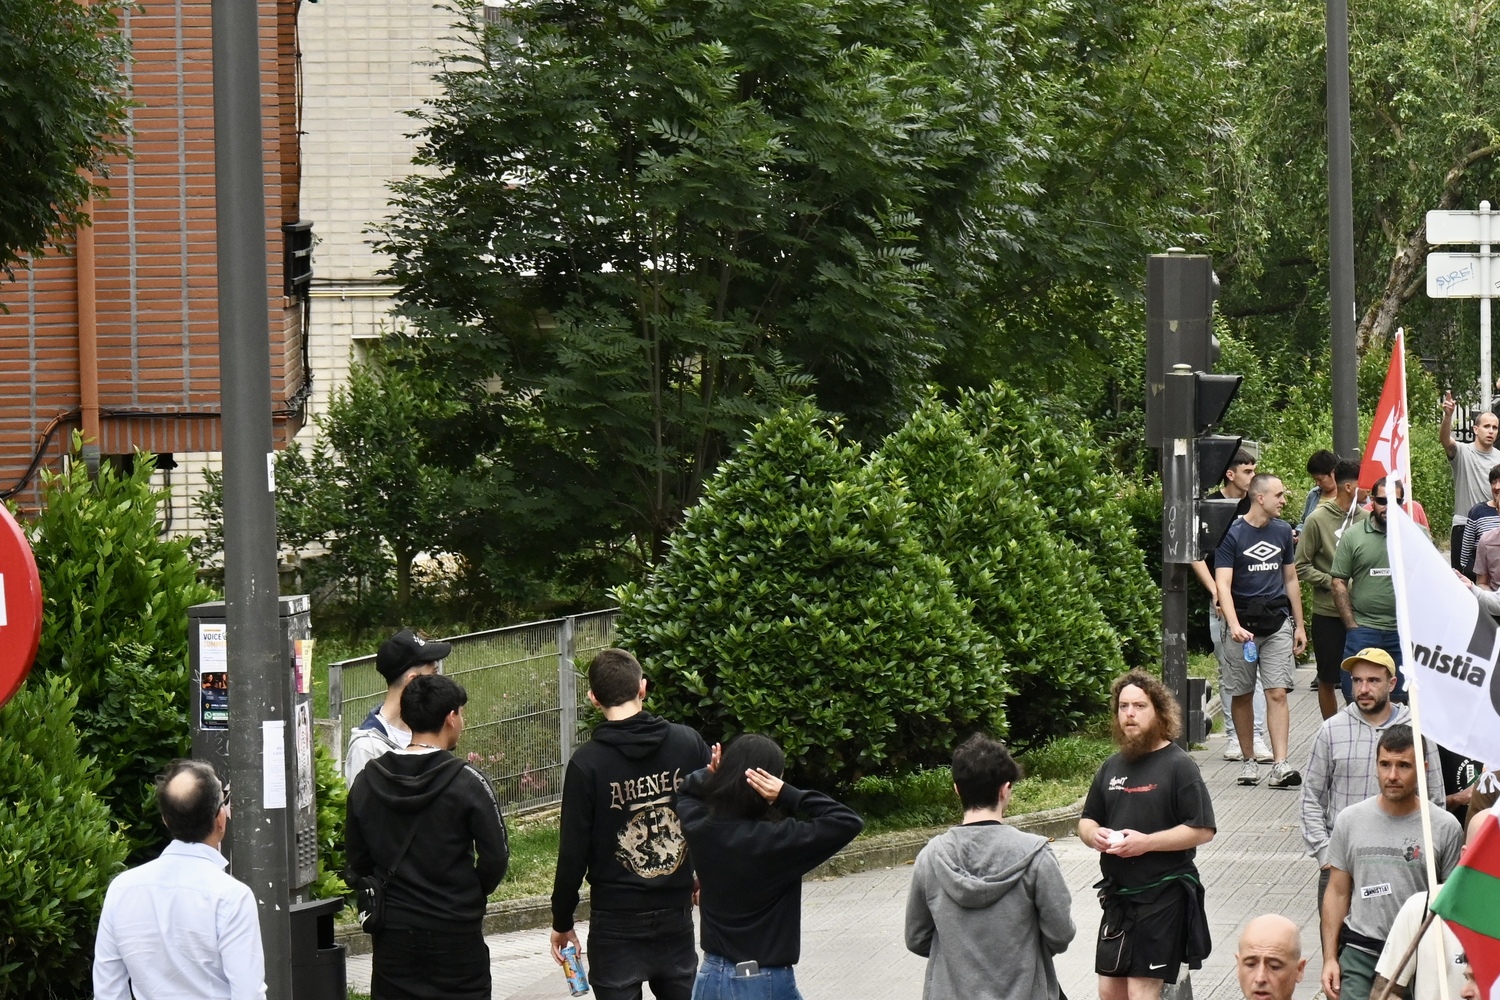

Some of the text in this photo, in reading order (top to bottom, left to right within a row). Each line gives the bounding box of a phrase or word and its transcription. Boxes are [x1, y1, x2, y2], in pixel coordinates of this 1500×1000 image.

[1435, 262, 1475, 287] SURE!
[1248, 562, 1279, 572] umbro
[203, 633, 222, 641] VOICE
